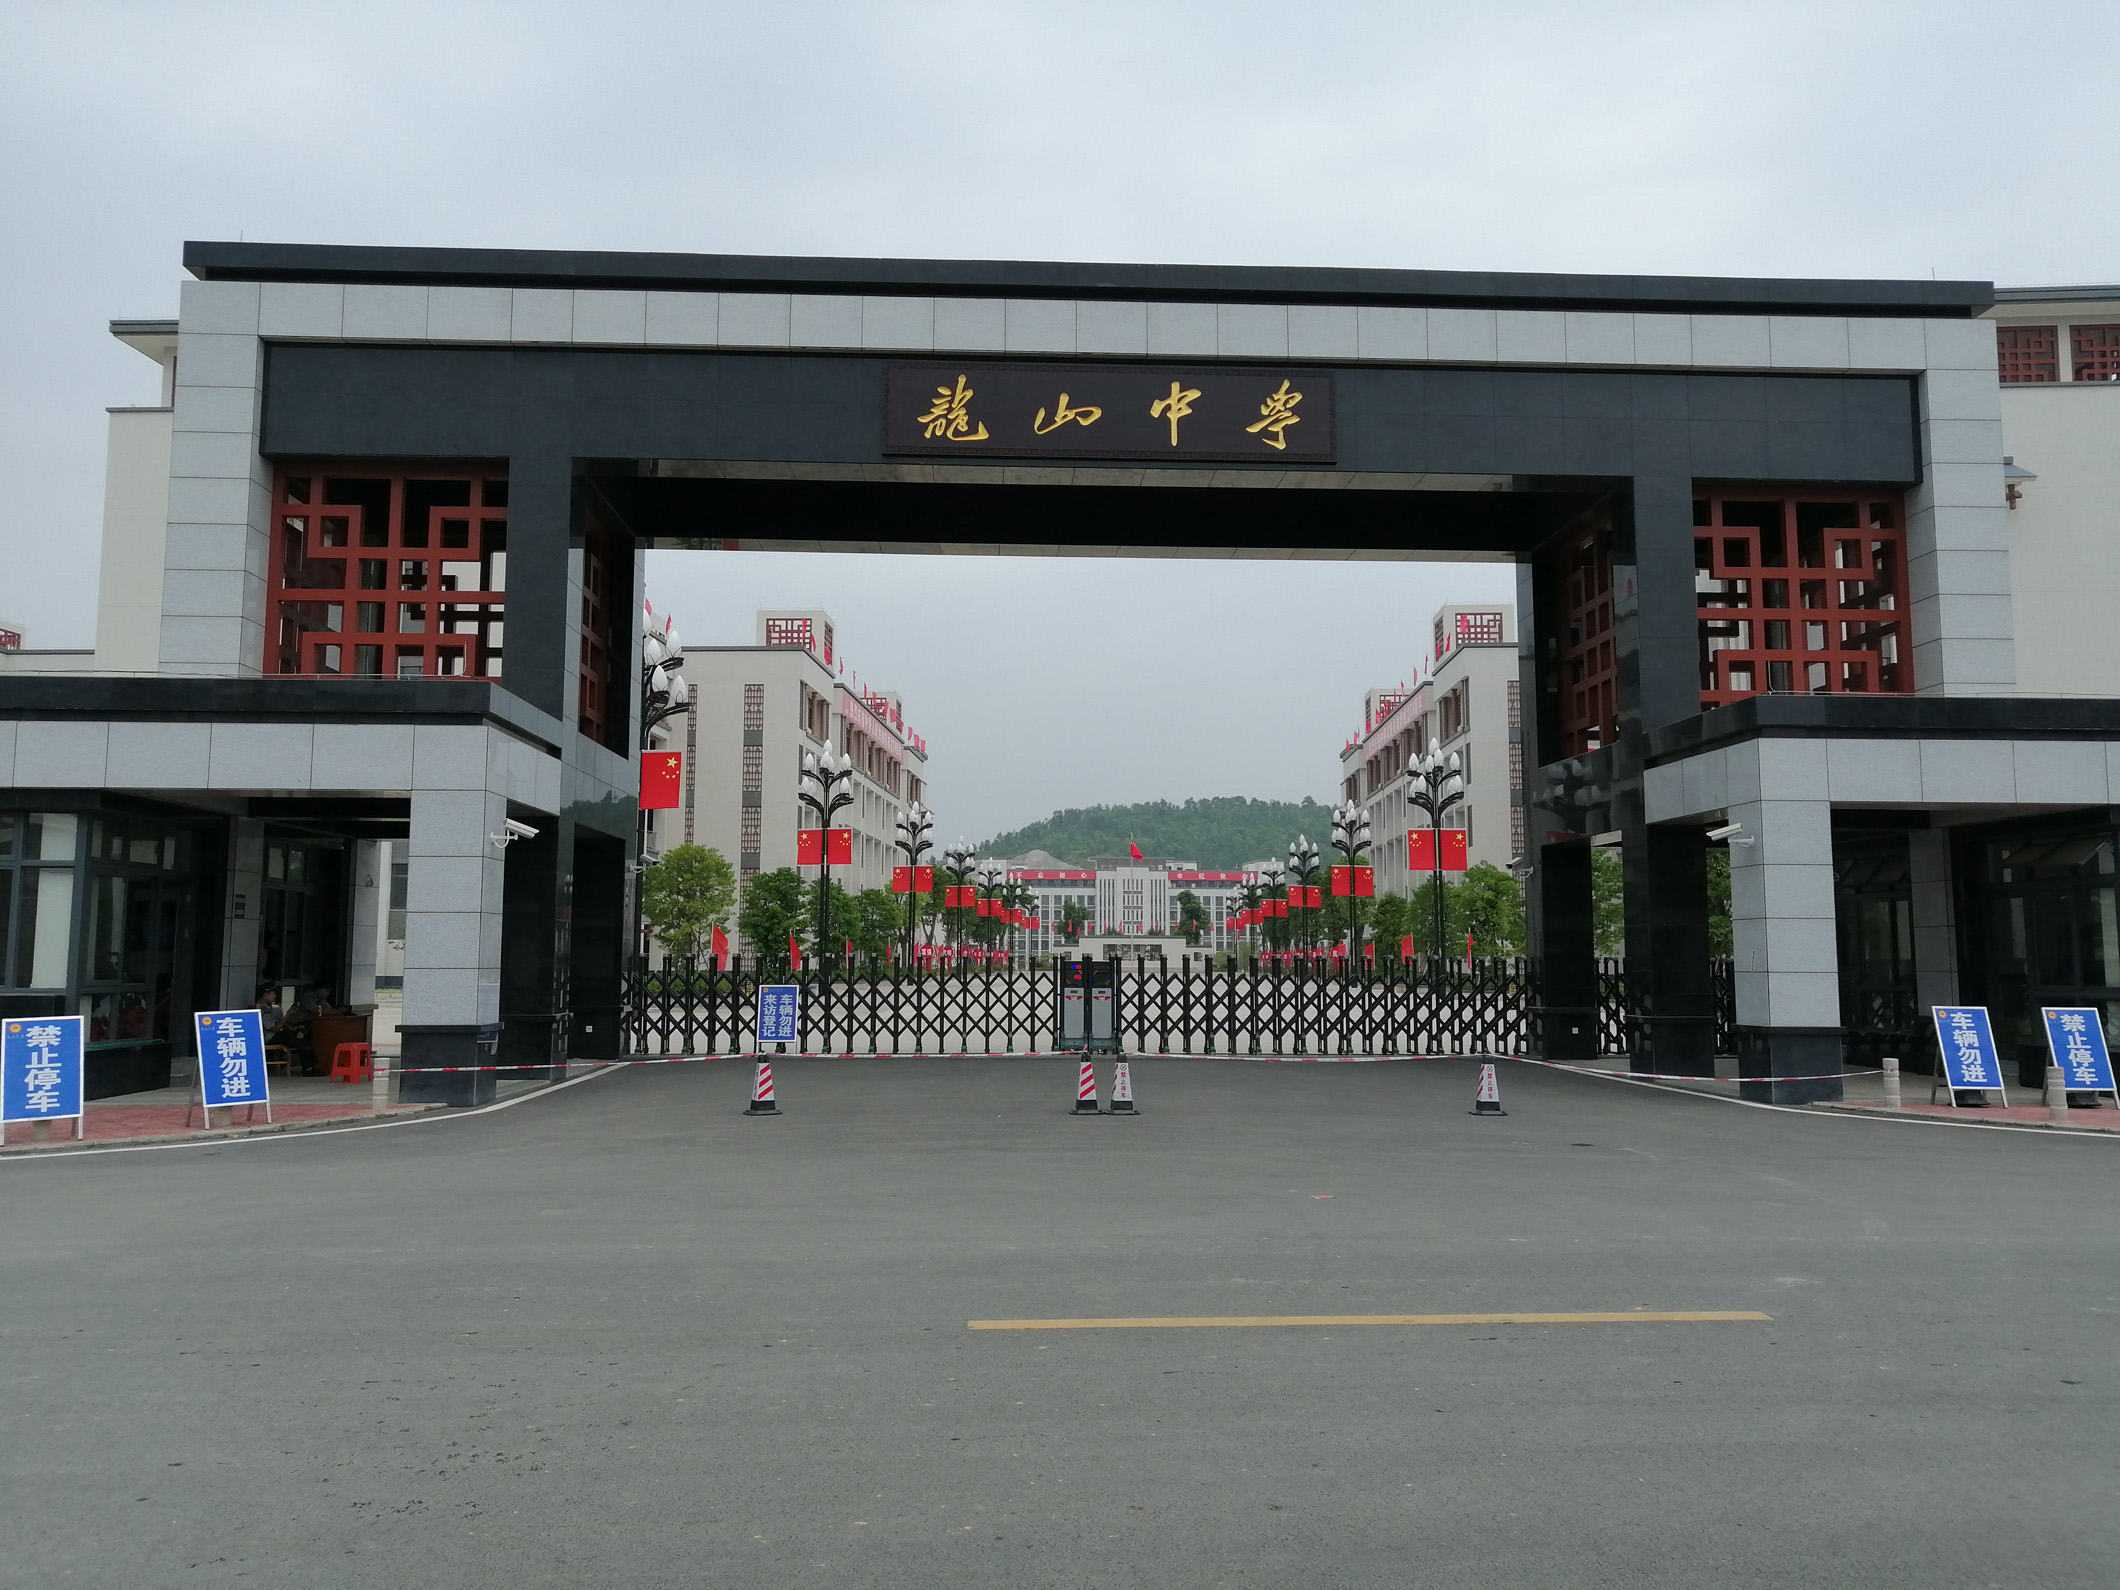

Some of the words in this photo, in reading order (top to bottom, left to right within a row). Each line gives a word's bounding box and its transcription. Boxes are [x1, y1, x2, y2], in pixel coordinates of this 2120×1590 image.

[762, 993, 777, 1037] 来访登记
[778, 993, 793, 1037] 车辆勿进
[1950, 1012, 1987, 1083] 车辆勿进
[2060, 1014, 2099, 1085] 禁止停车
[24, 1025, 62, 1113] 禁止停车
[216, 1017, 251, 1098] 车辆勿进
